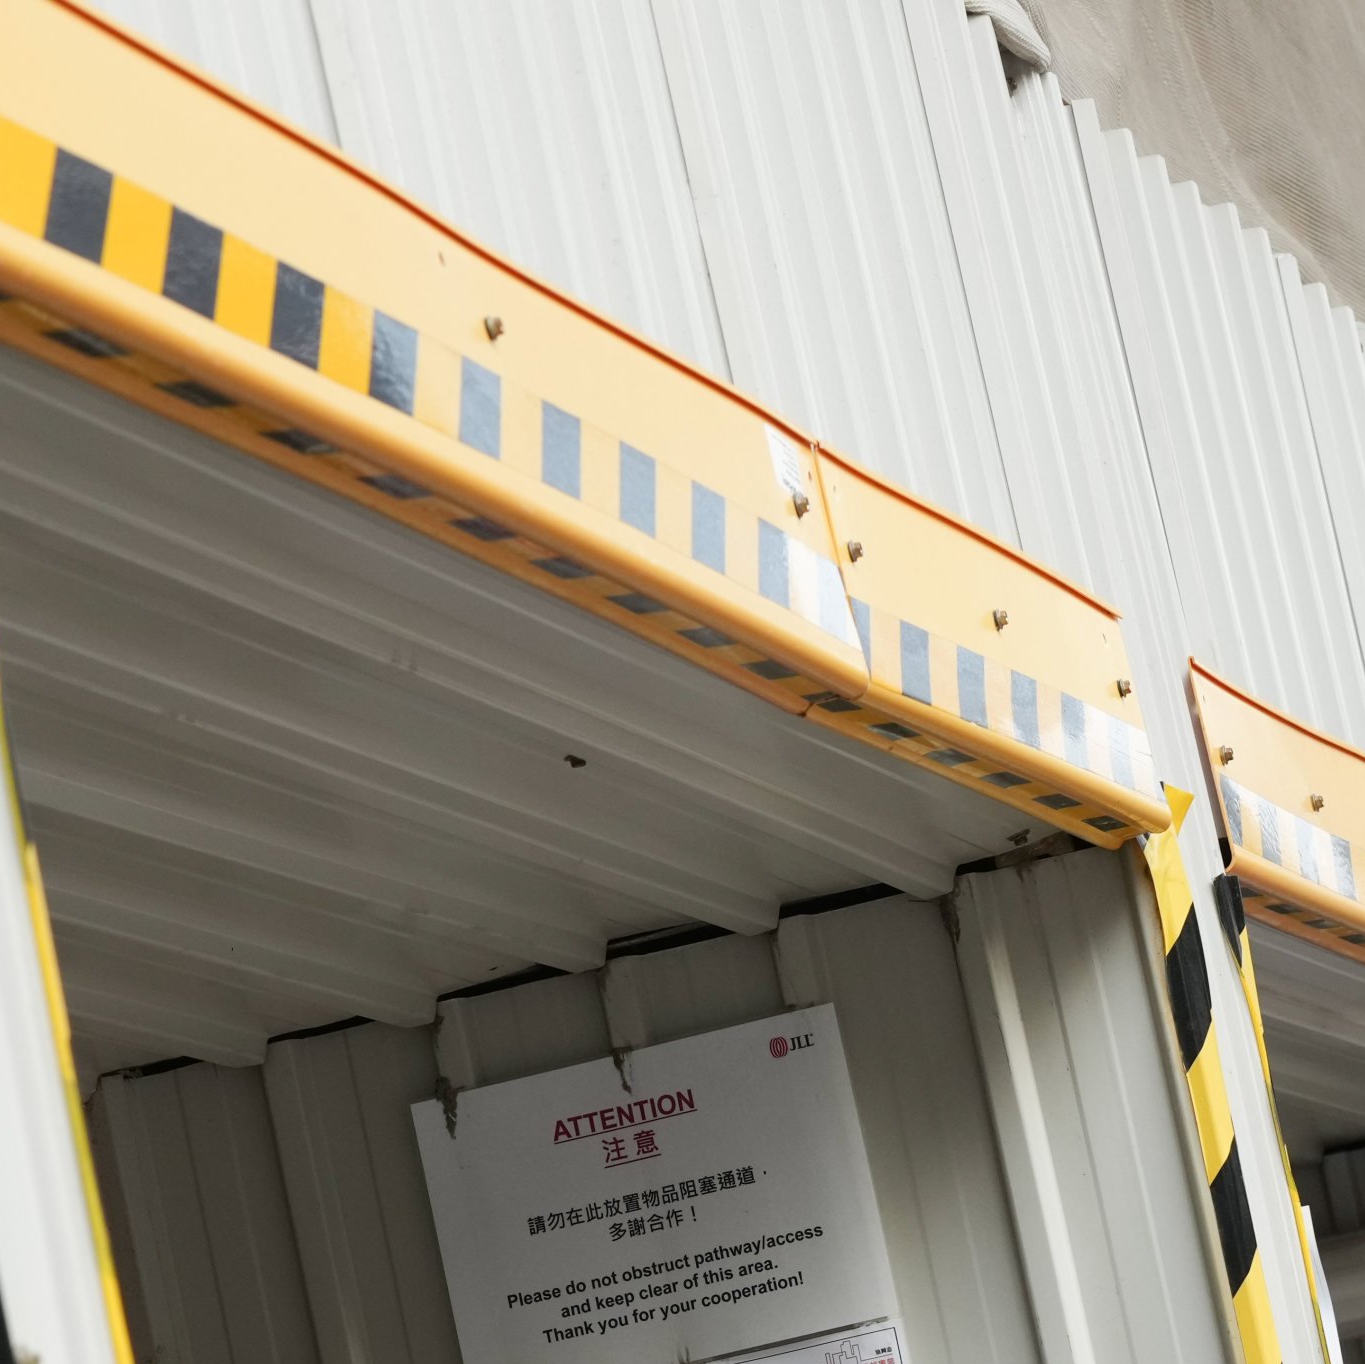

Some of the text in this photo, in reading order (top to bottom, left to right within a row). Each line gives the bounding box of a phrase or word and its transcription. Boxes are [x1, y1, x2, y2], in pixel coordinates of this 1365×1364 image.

[789, 1033, 815, 1052] JLL
[553, 1088, 695, 1142] ATTENTION
[601, 1129, 659, 1164] 注意
[506, 1225, 824, 1309] Please do not obstruct pathway/access
[560, 1259, 779, 1319] and keep clear of this area.
[541, 1270, 804, 1344] Thank you for your cooperation!
